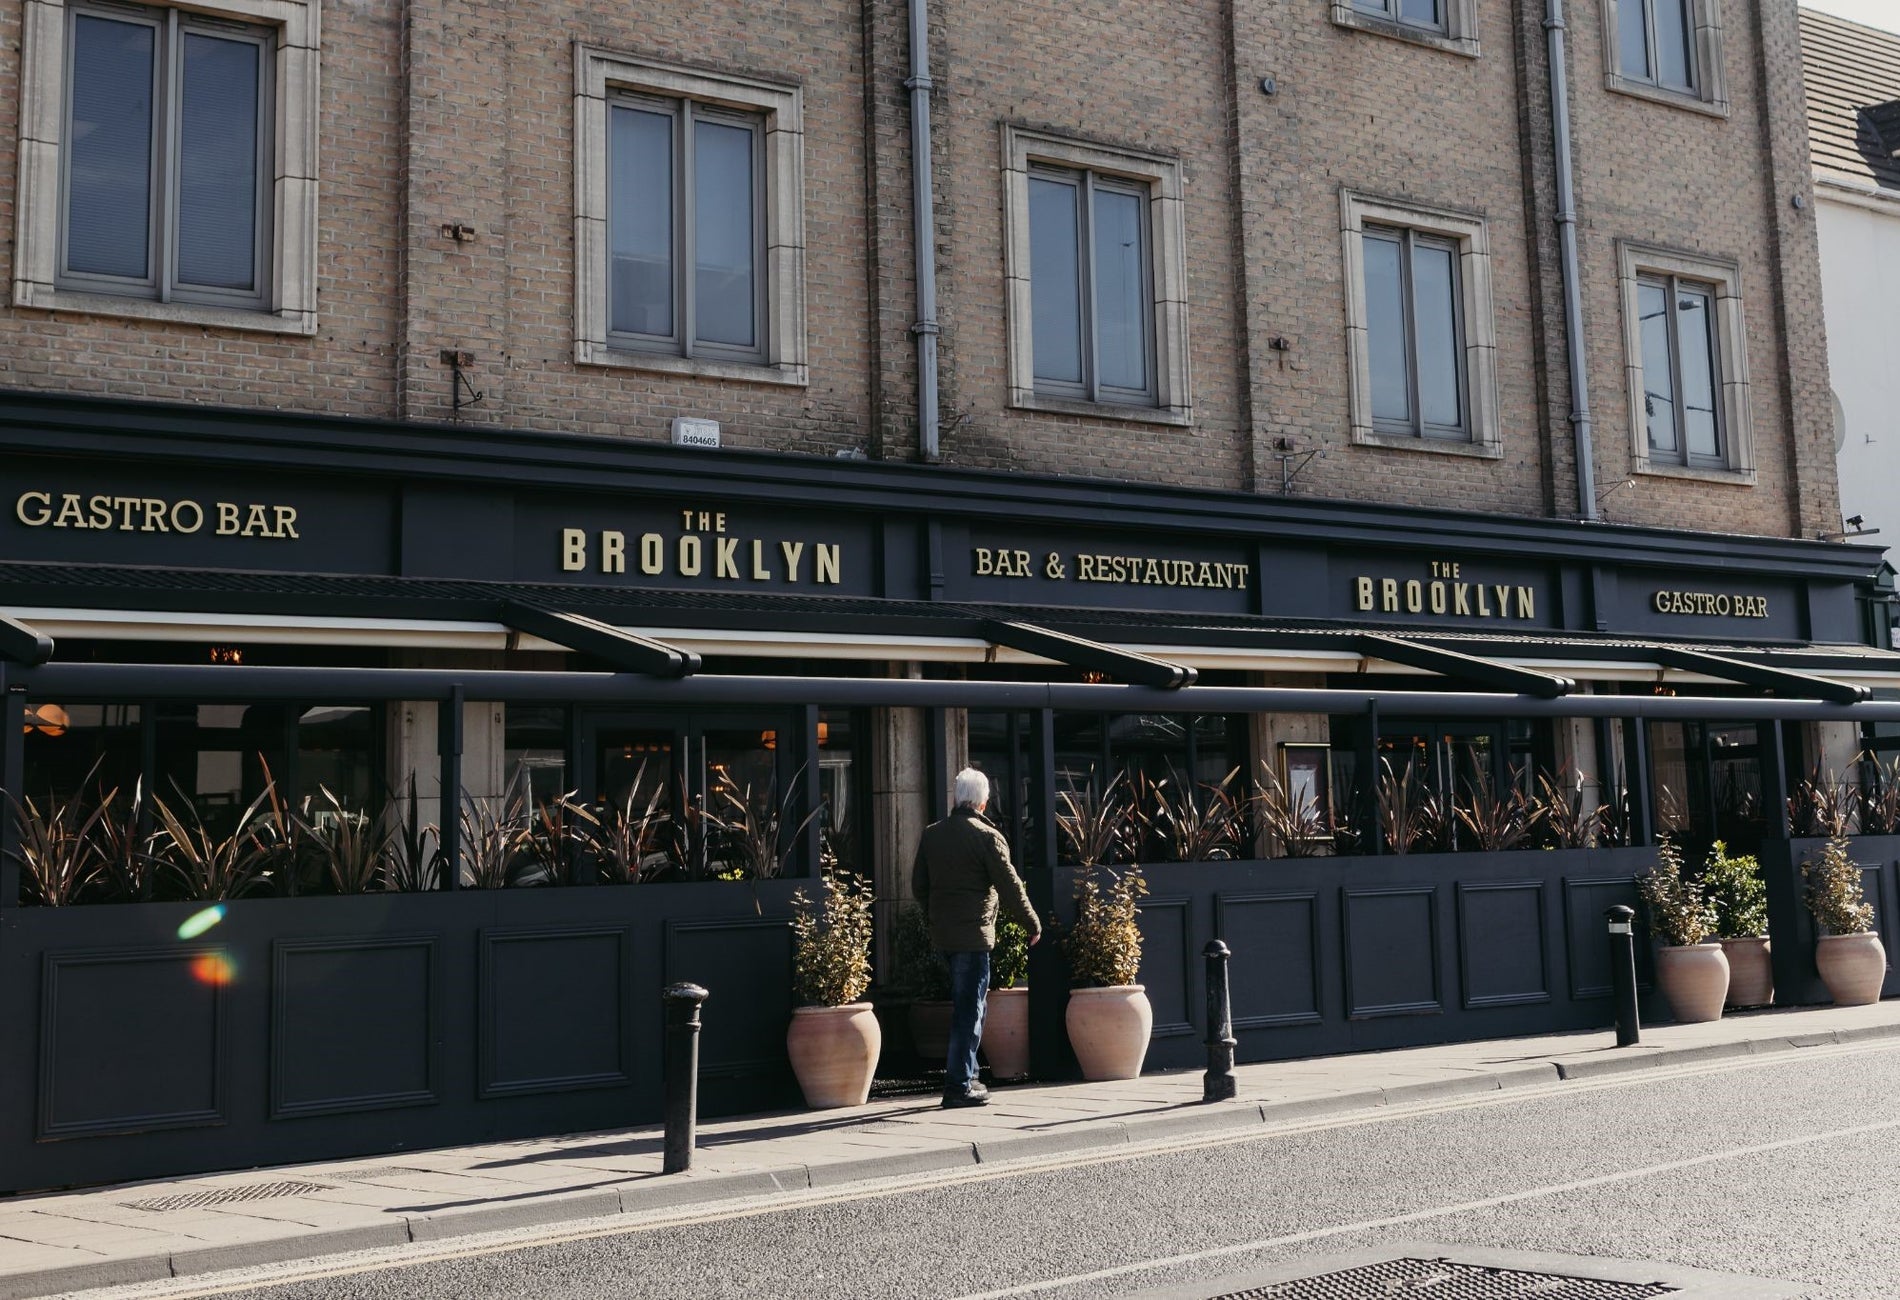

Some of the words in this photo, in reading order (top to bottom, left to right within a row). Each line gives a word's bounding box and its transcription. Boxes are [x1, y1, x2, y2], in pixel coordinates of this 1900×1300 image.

[682, 434, 718, 447] 8404605
[16, 491, 204, 533] GASTRO
[215, 502, 300, 538] BAR
[683, 510, 726, 532] THE
[563, 528, 840, 583] BROOKLYN
[976, 548, 1032, 577] BAR
[1046, 552, 1065, 579] &
[1077, 553, 1249, 589] RESTAURANT
[1432, 561, 1460, 578] THE
[1358, 576, 1533, 618] BROOKLYN
[1656, 591, 1730, 615] GASTRO
[1734, 595, 1768, 618] BAR
